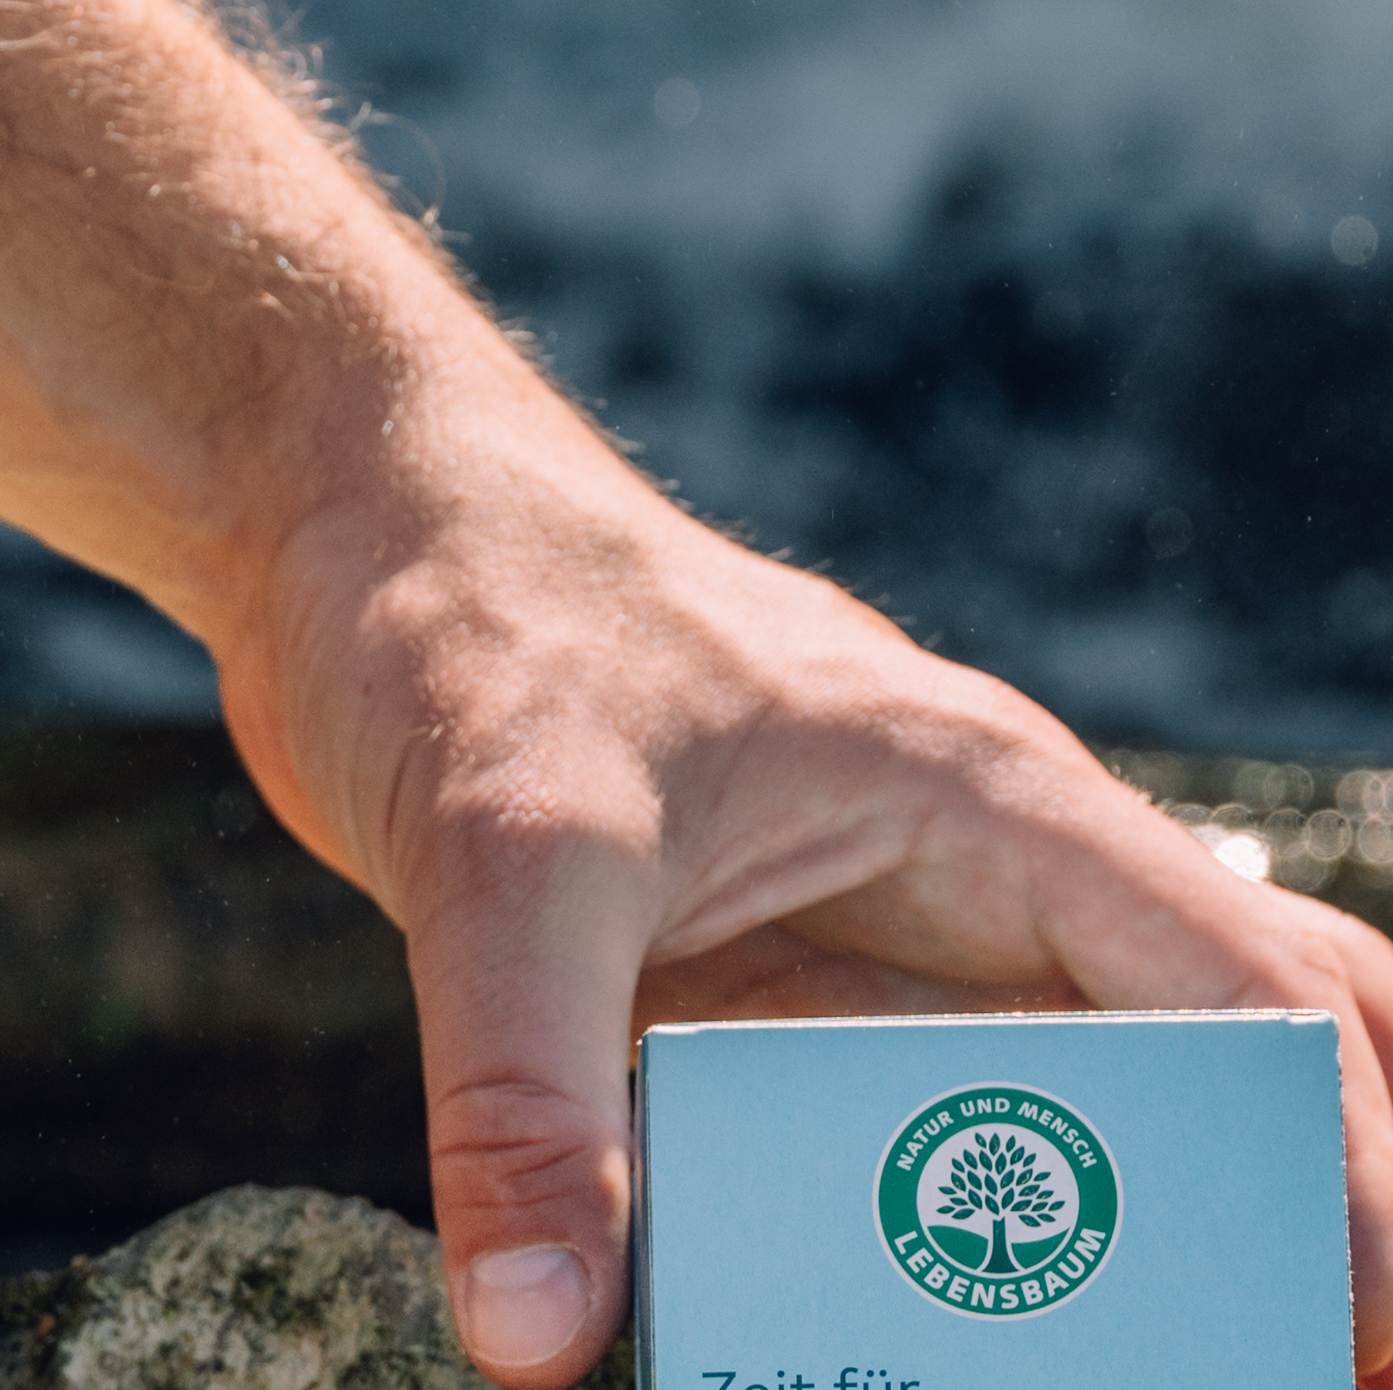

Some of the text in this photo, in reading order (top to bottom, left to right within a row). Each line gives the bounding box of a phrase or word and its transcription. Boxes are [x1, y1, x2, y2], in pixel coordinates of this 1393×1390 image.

[896, 1097, 1098, 1171] NATUR UND MENSCH
[893, 1227, 1107, 1310] LEBENSBAUM
